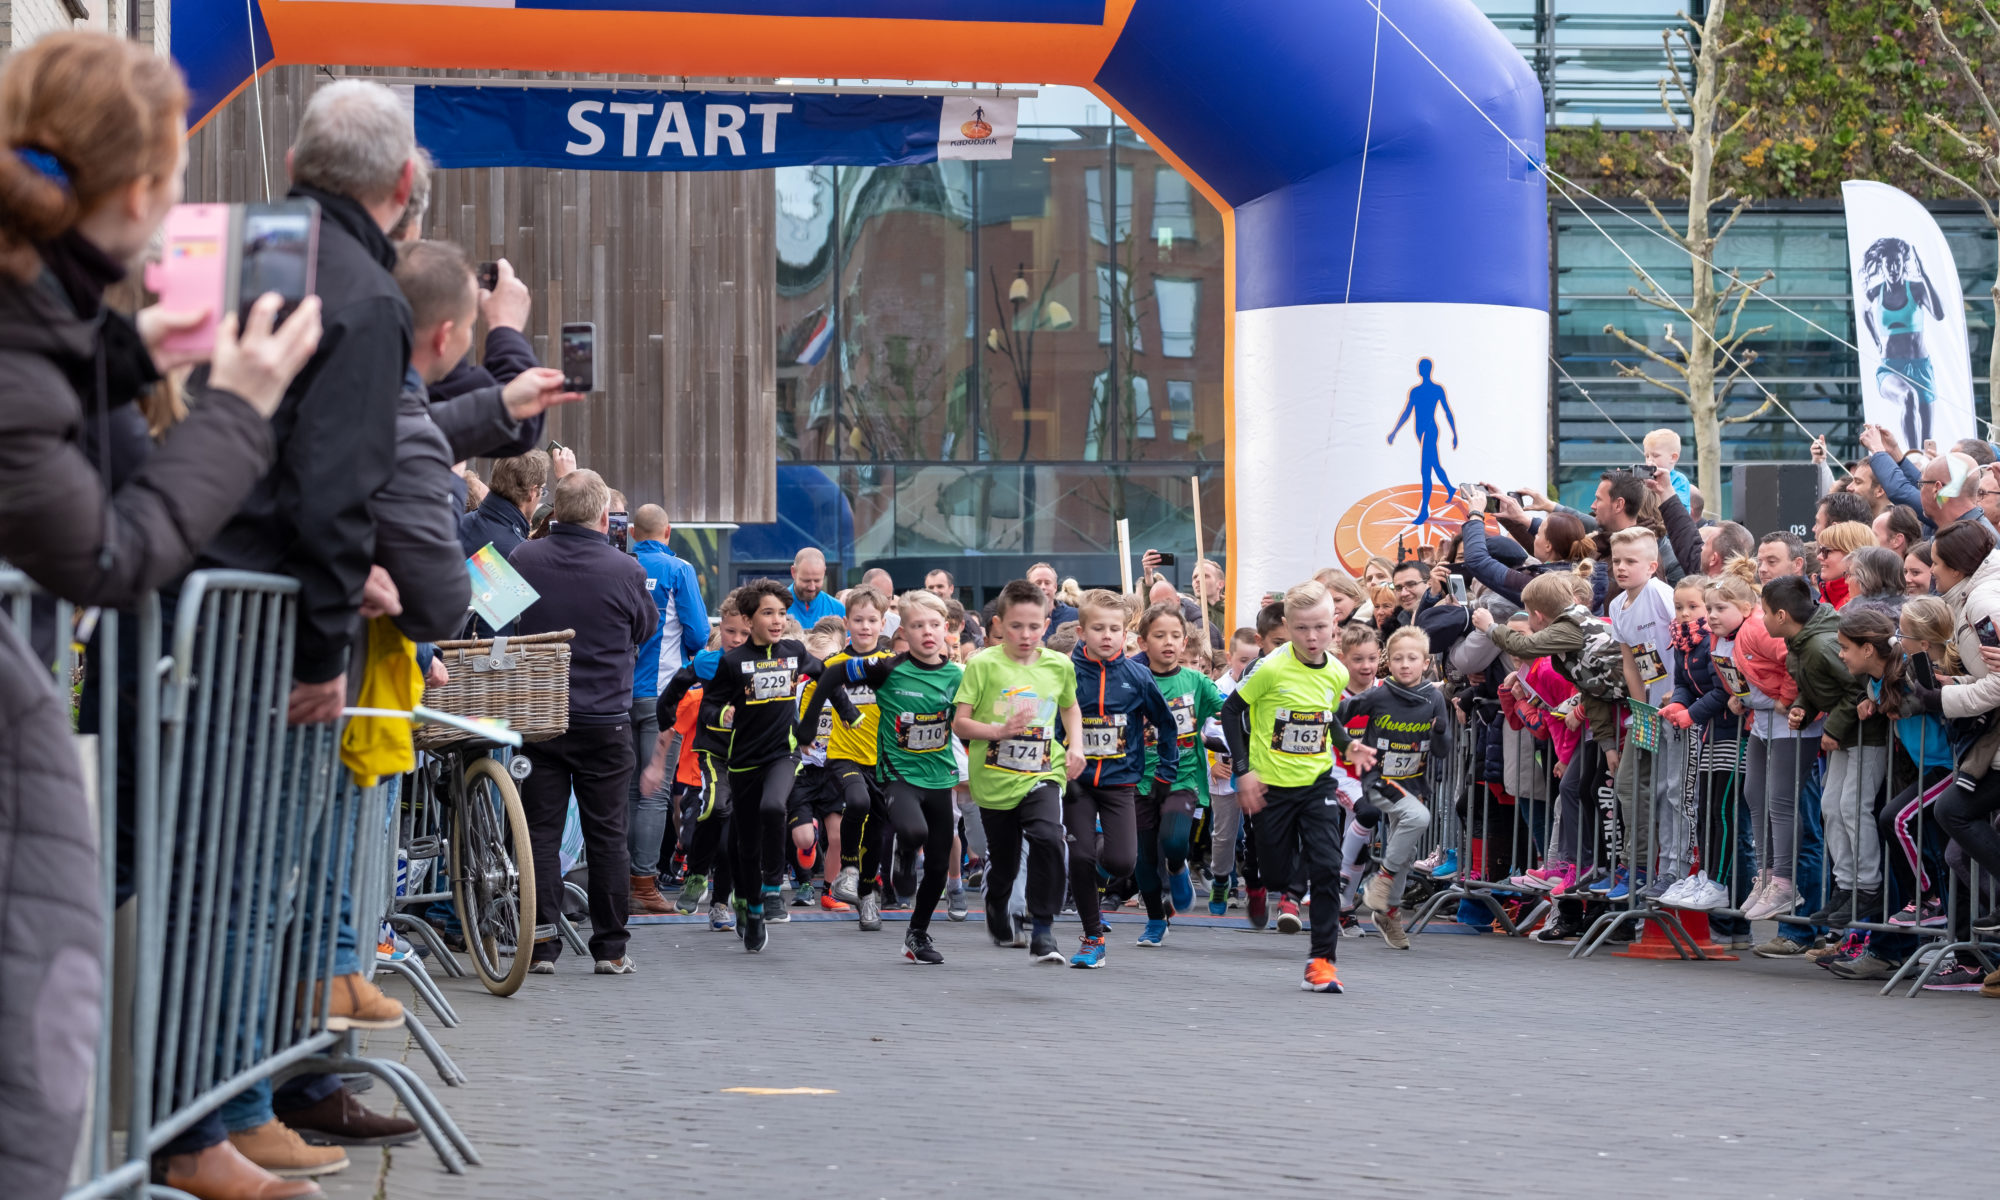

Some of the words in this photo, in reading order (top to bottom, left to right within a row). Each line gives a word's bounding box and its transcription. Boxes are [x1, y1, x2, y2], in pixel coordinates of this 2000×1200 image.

[565, 100, 793, 157] START
[1790, 524, 1807, 536] 03
[760, 675, 786, 690] 229
[917, 727, 942, 741] 110
[1085, 733, 1112, 746] 119
[1292, 729, 1319, 743] 163
[1008, 745, 1037, 760] 174
[1394, 757, 1412, 768] 57
